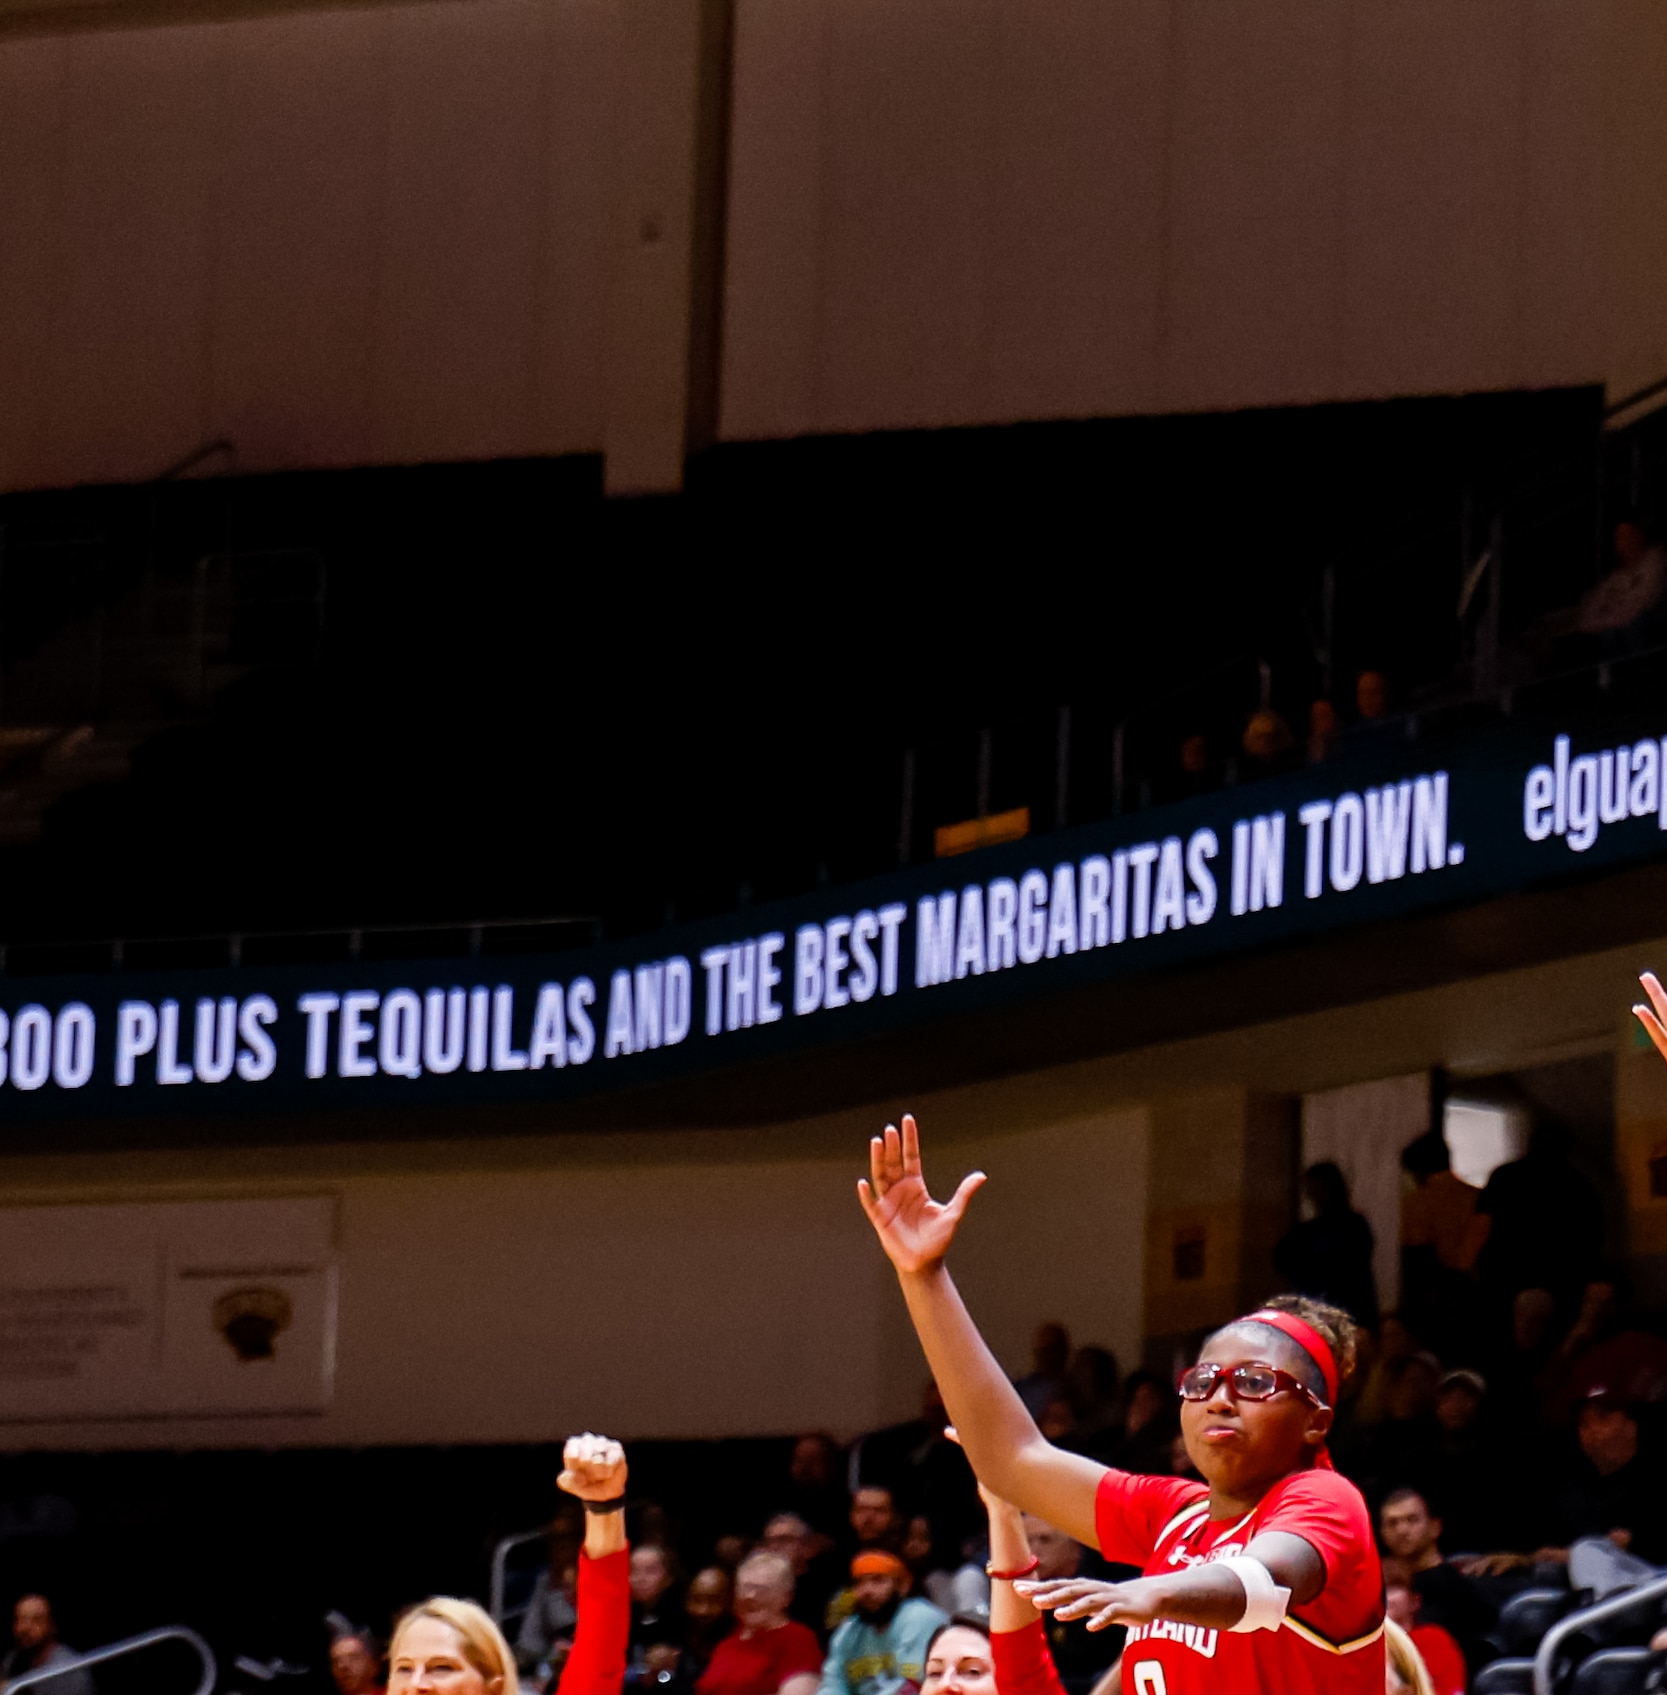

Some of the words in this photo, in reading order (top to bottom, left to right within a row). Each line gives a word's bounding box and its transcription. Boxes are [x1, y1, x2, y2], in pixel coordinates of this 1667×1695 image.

[114, 993, 279, 1087] PLUS
[297, 976, 596, 1080] TEQUILAS
[603, 954, 692, 1059] AND
[701, 930, 785, 1036] THE
[793, 902, 907, 1018] BEST
[914, 827, 1219, 989] MARGARITAS
[1230, 810, 1287, 917] IN
[1298, 770, 1466, 900] TOWN.
